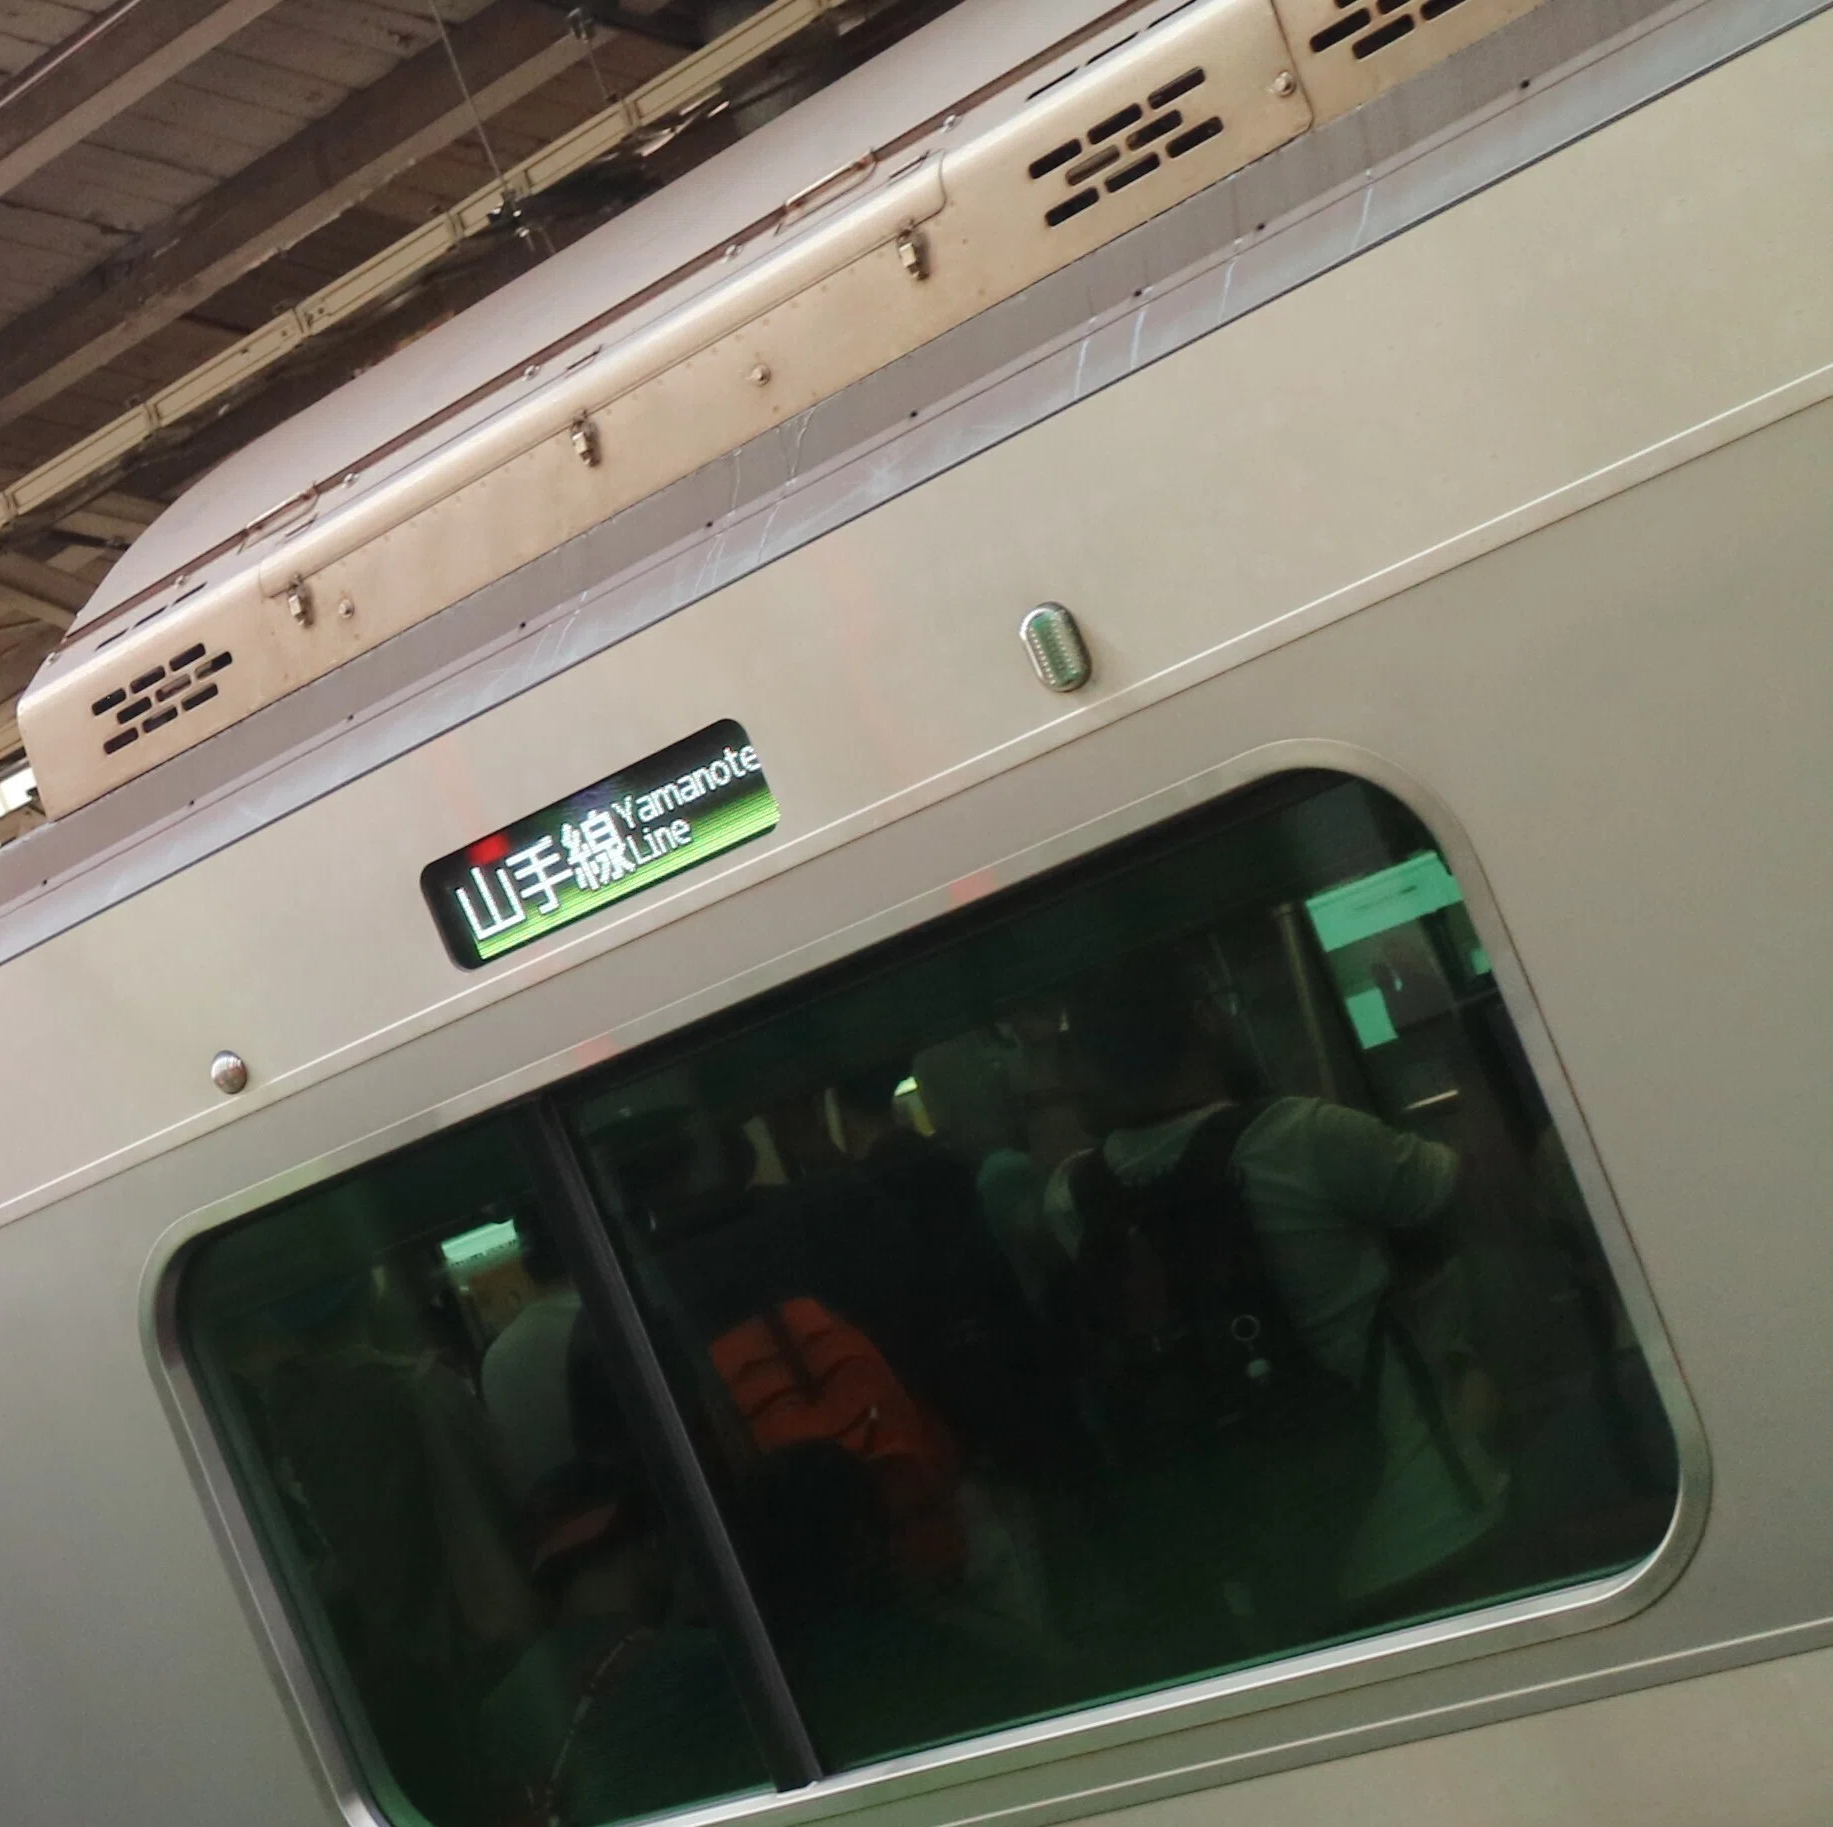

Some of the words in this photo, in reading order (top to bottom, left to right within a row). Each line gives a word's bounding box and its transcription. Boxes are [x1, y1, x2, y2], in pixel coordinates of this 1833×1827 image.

[621, 743, 763, 831] Yamanote
[456, 811, 638, 942] 山手線
[631, 817, 693, 866] Line
